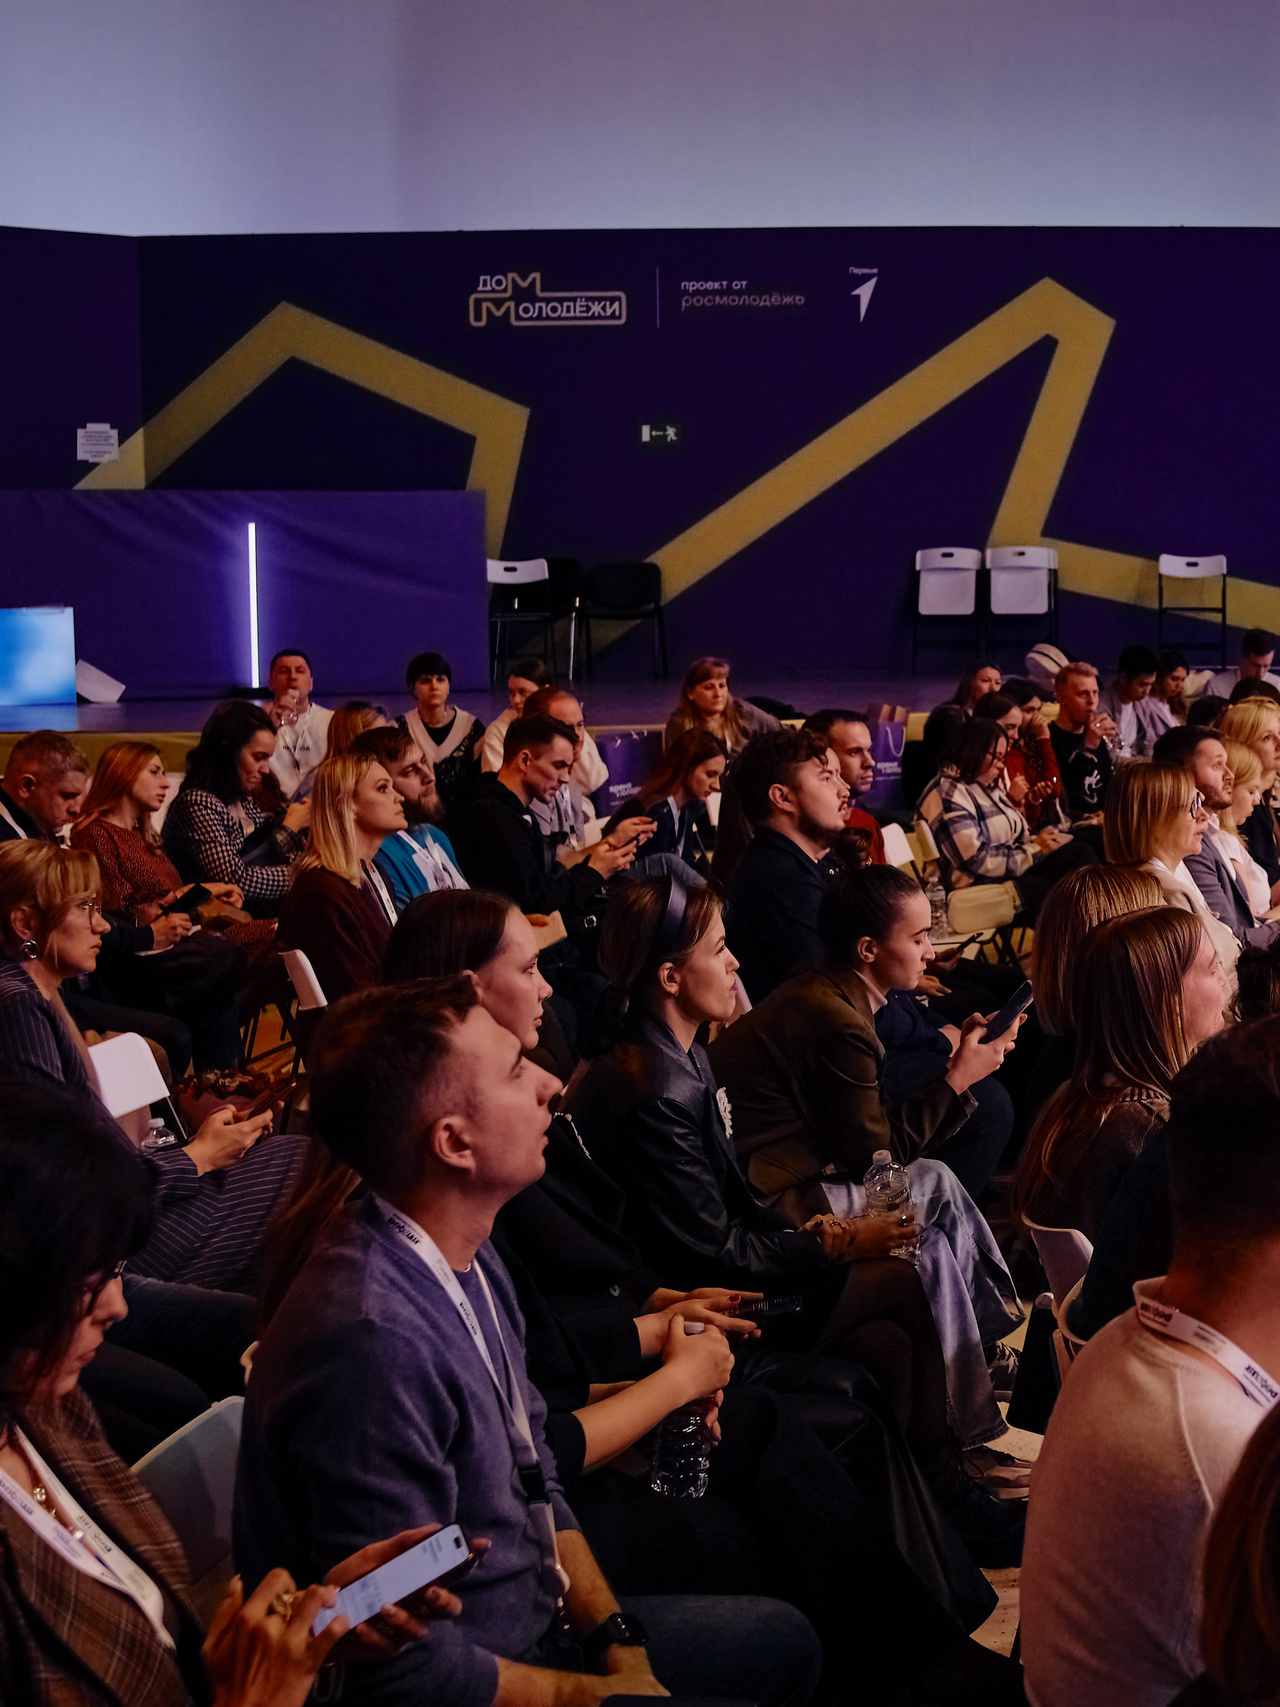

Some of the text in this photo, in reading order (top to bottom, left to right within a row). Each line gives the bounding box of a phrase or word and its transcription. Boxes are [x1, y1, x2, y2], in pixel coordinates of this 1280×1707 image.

[680, 280, 748, 293] проект от
[681, 292, 806, 312] росмолодёжь
